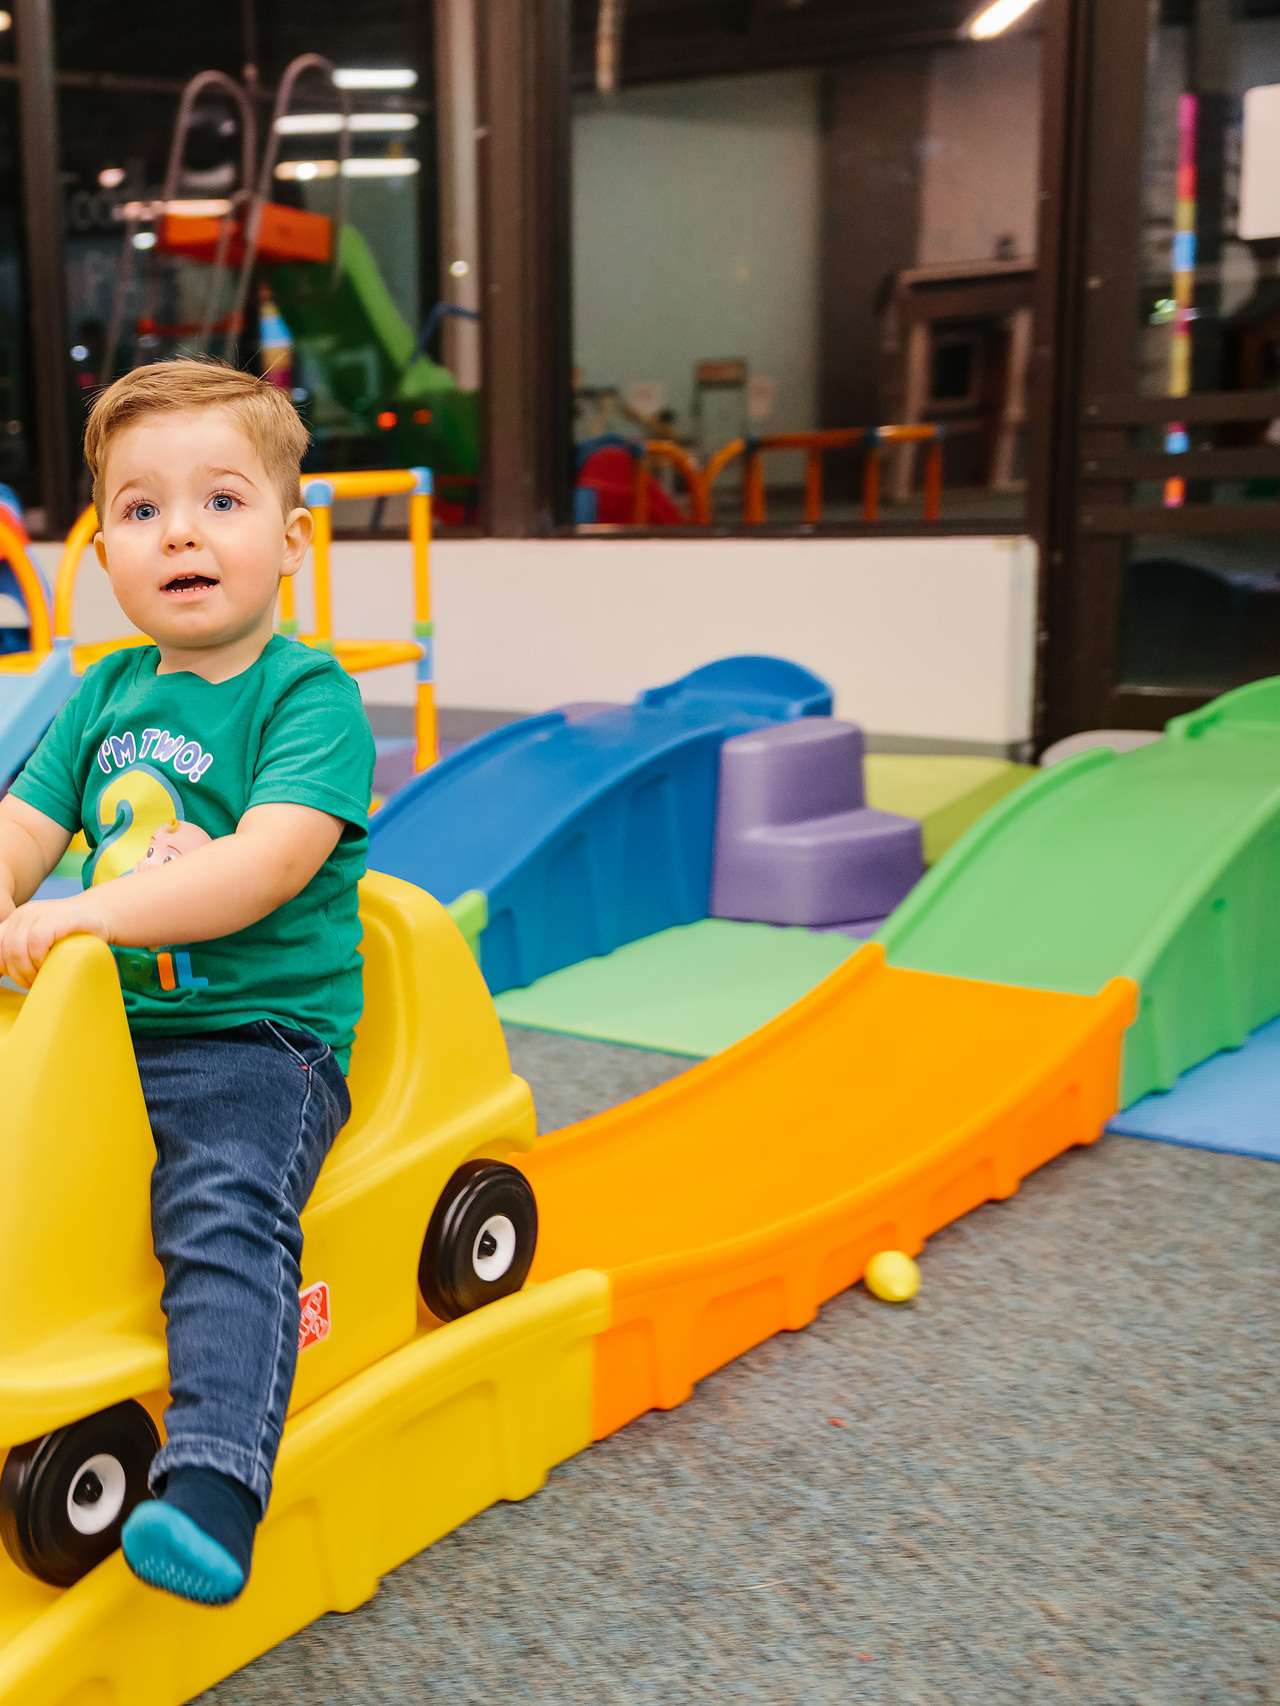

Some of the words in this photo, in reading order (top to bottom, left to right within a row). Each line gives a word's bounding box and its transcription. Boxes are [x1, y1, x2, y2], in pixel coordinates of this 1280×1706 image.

[97, 731, 136, 774] I'M
[138, 728, 214, 783] TWO!
[91, 761, 185, 888] 2
